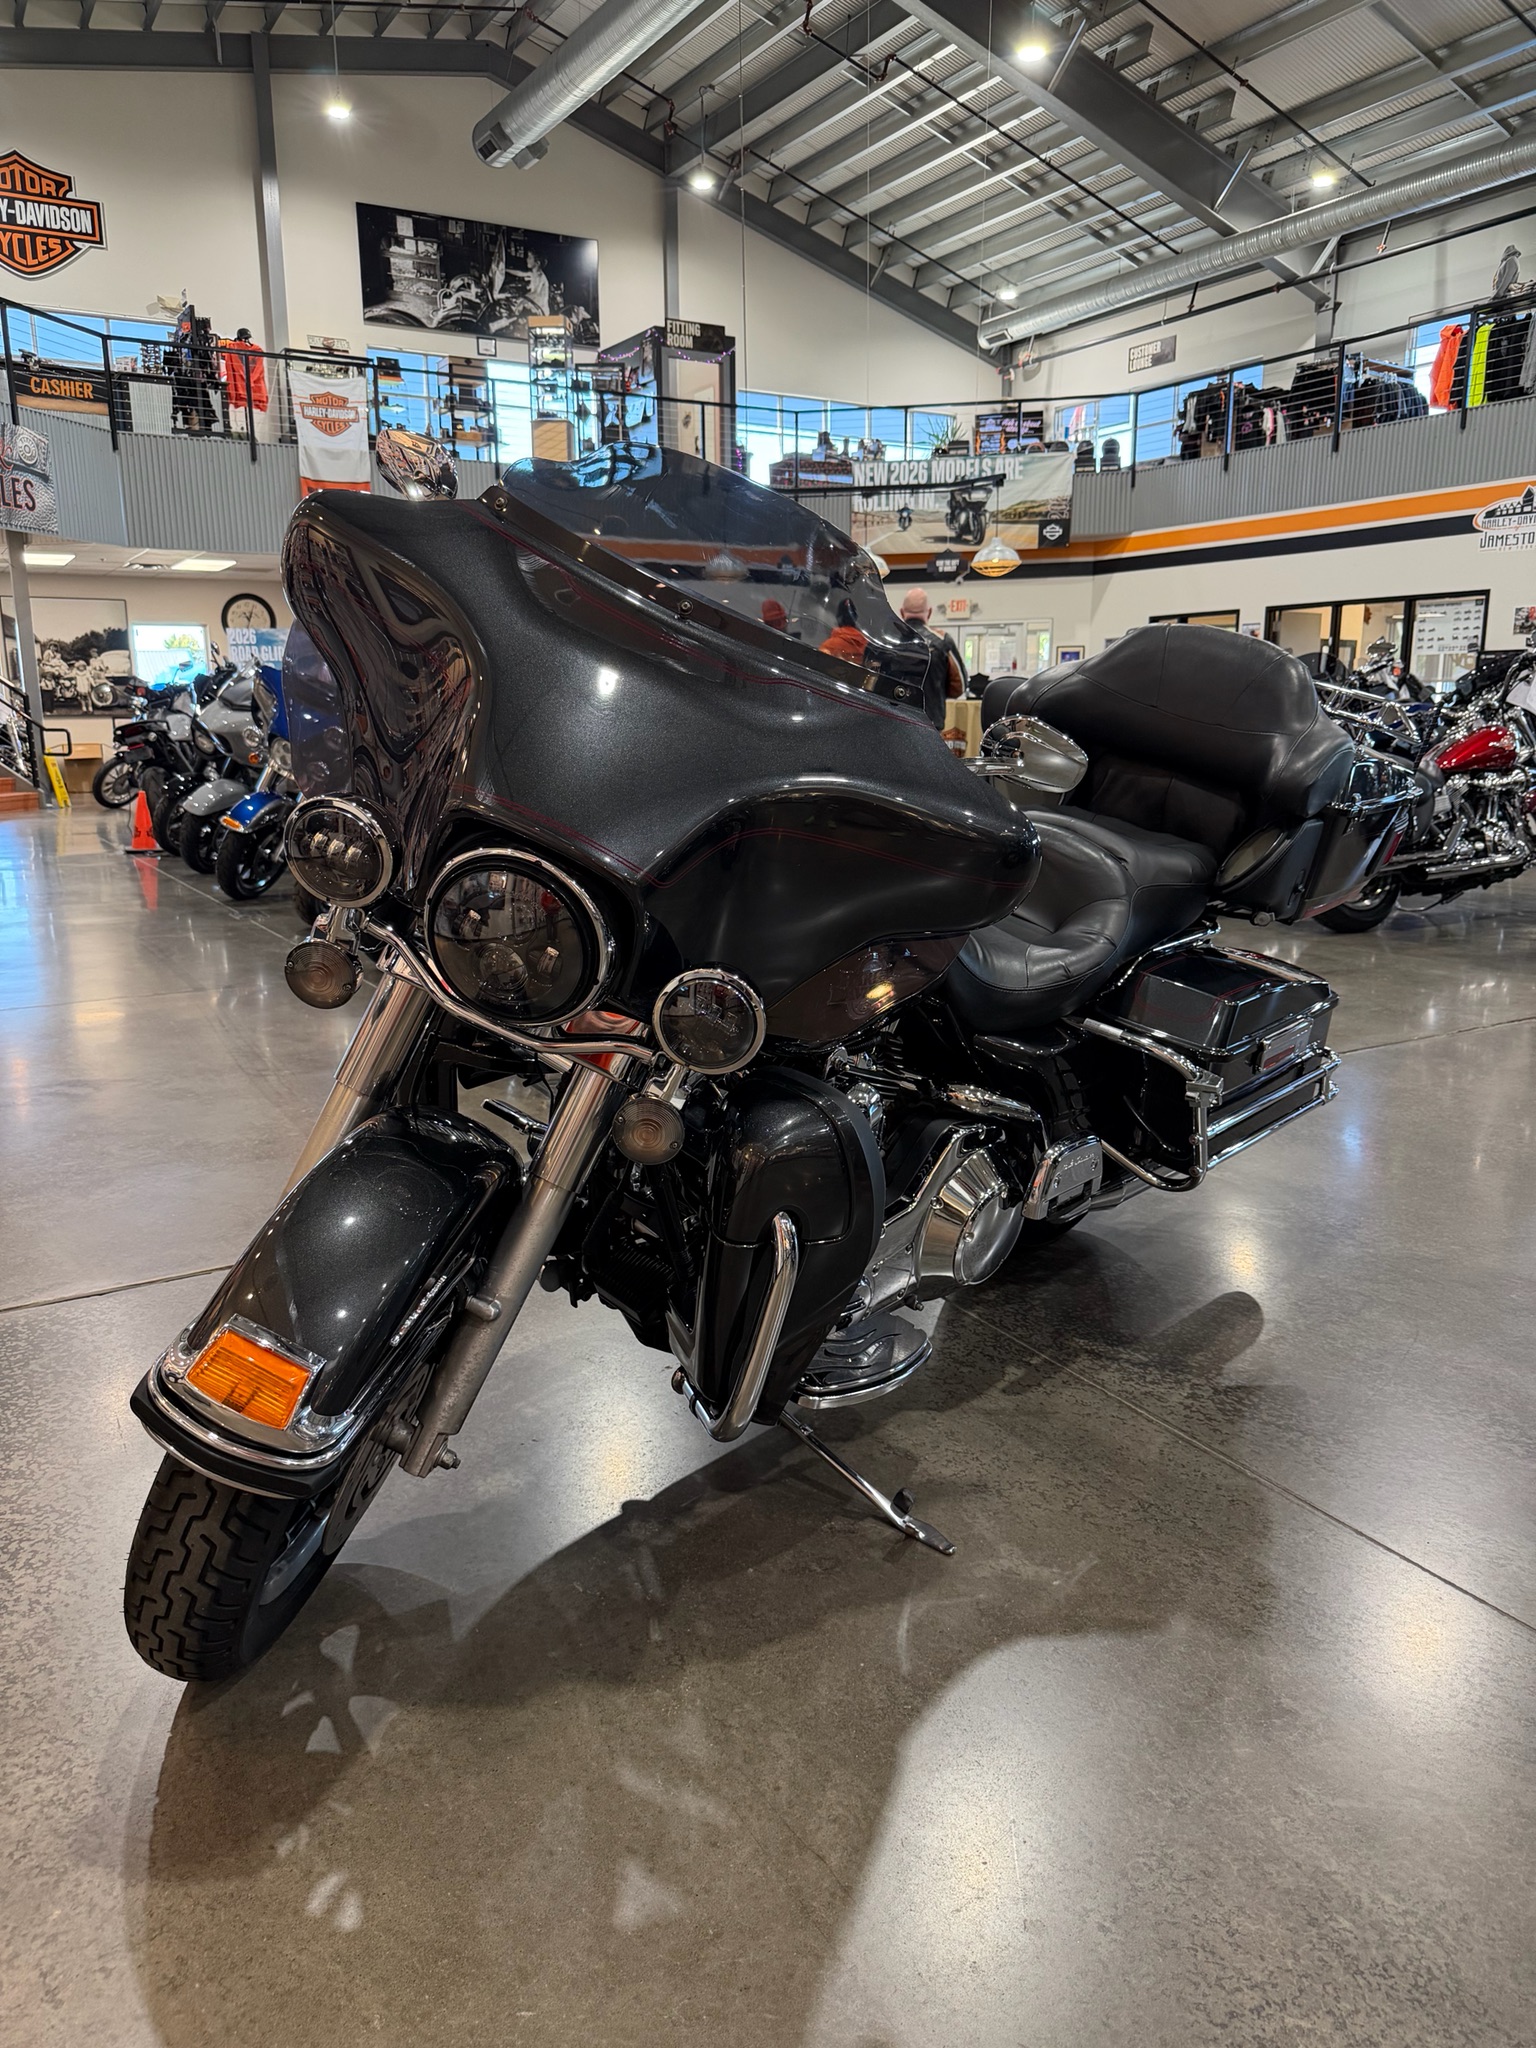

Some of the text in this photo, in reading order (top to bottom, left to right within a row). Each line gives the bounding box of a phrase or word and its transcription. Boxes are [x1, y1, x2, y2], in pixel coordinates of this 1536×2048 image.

[666, 320, 701, 337] FITTING
[666, 333, 694, 349] ROOM
[1130, 341, 1161, 360] CUSTOMER
[1130, 355, 1153, 372] LOUNGE
[30, 376, 94, 399] CASHIER
[315, 396, 344, 407] MOTOR
[304, 406, 356, 419] HARLEY-DAVIDSON
[316, 421, 345, 433] CYCLES
[853, 461, 889, 487] NEW
[890, 460, 928, 486] 2026
[994, 456, 1024, 481] ARE
[950, 599, 967, 612] EXIT
[229, 629, 257, 645] 2026
